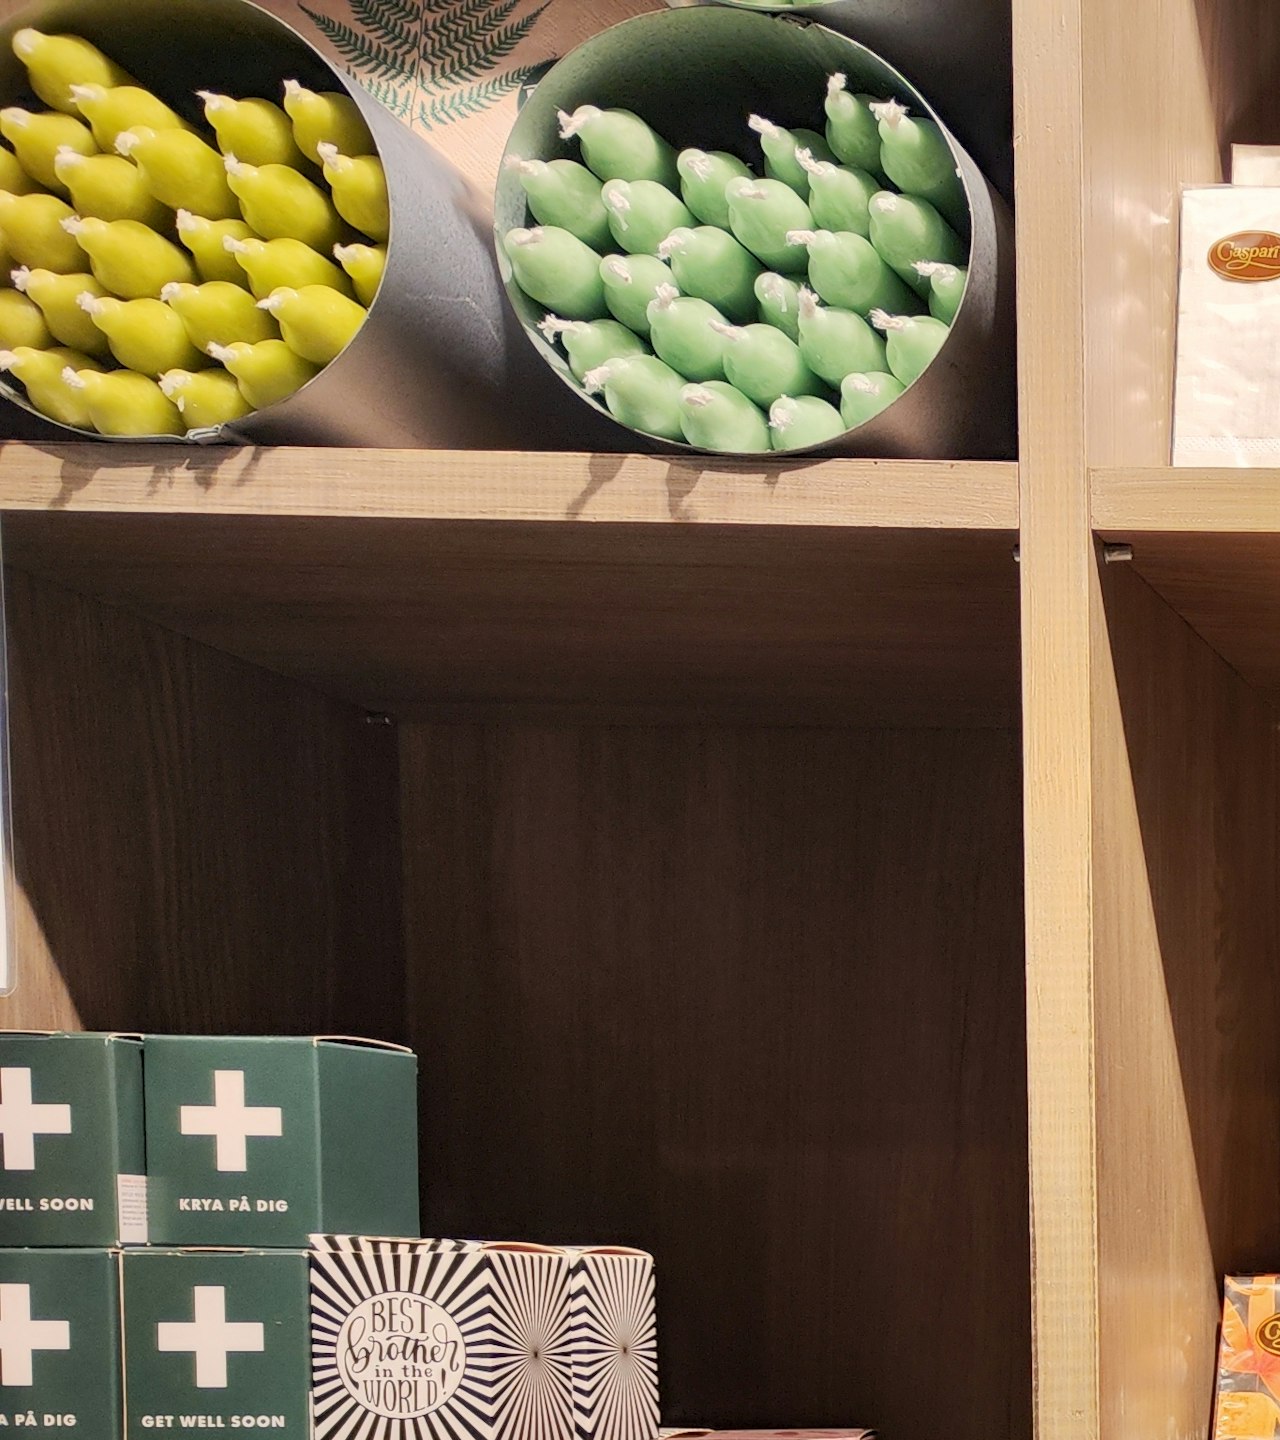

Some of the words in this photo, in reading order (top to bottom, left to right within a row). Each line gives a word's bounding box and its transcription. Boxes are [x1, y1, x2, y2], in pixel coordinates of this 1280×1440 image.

[0, 1198, 34, 1211] ELL
[39, 1198, 94, 1211] SOON
[179, 1198, 224, 1211] KRYA
[229, 1195, 251, 1212] PÅ
[257, 1199, 289, 1212] DIG
[372, 1297, 432, 1334] BEST
[346, 1315, 460, 1376] brother
[374, 1364, 393, 1378] in
[401, 1364, 433, 1378] the
[363, 1370, 448, 1413] WORLD!
[15, 1411, 38, 1427] PÅ
[43, 1414, 77, 1427] DIG
[141, 1415, 175, 1428] GET
[179, 1415, 225, 1428] WELL
[230, 1415, 285, 1428] SOON
